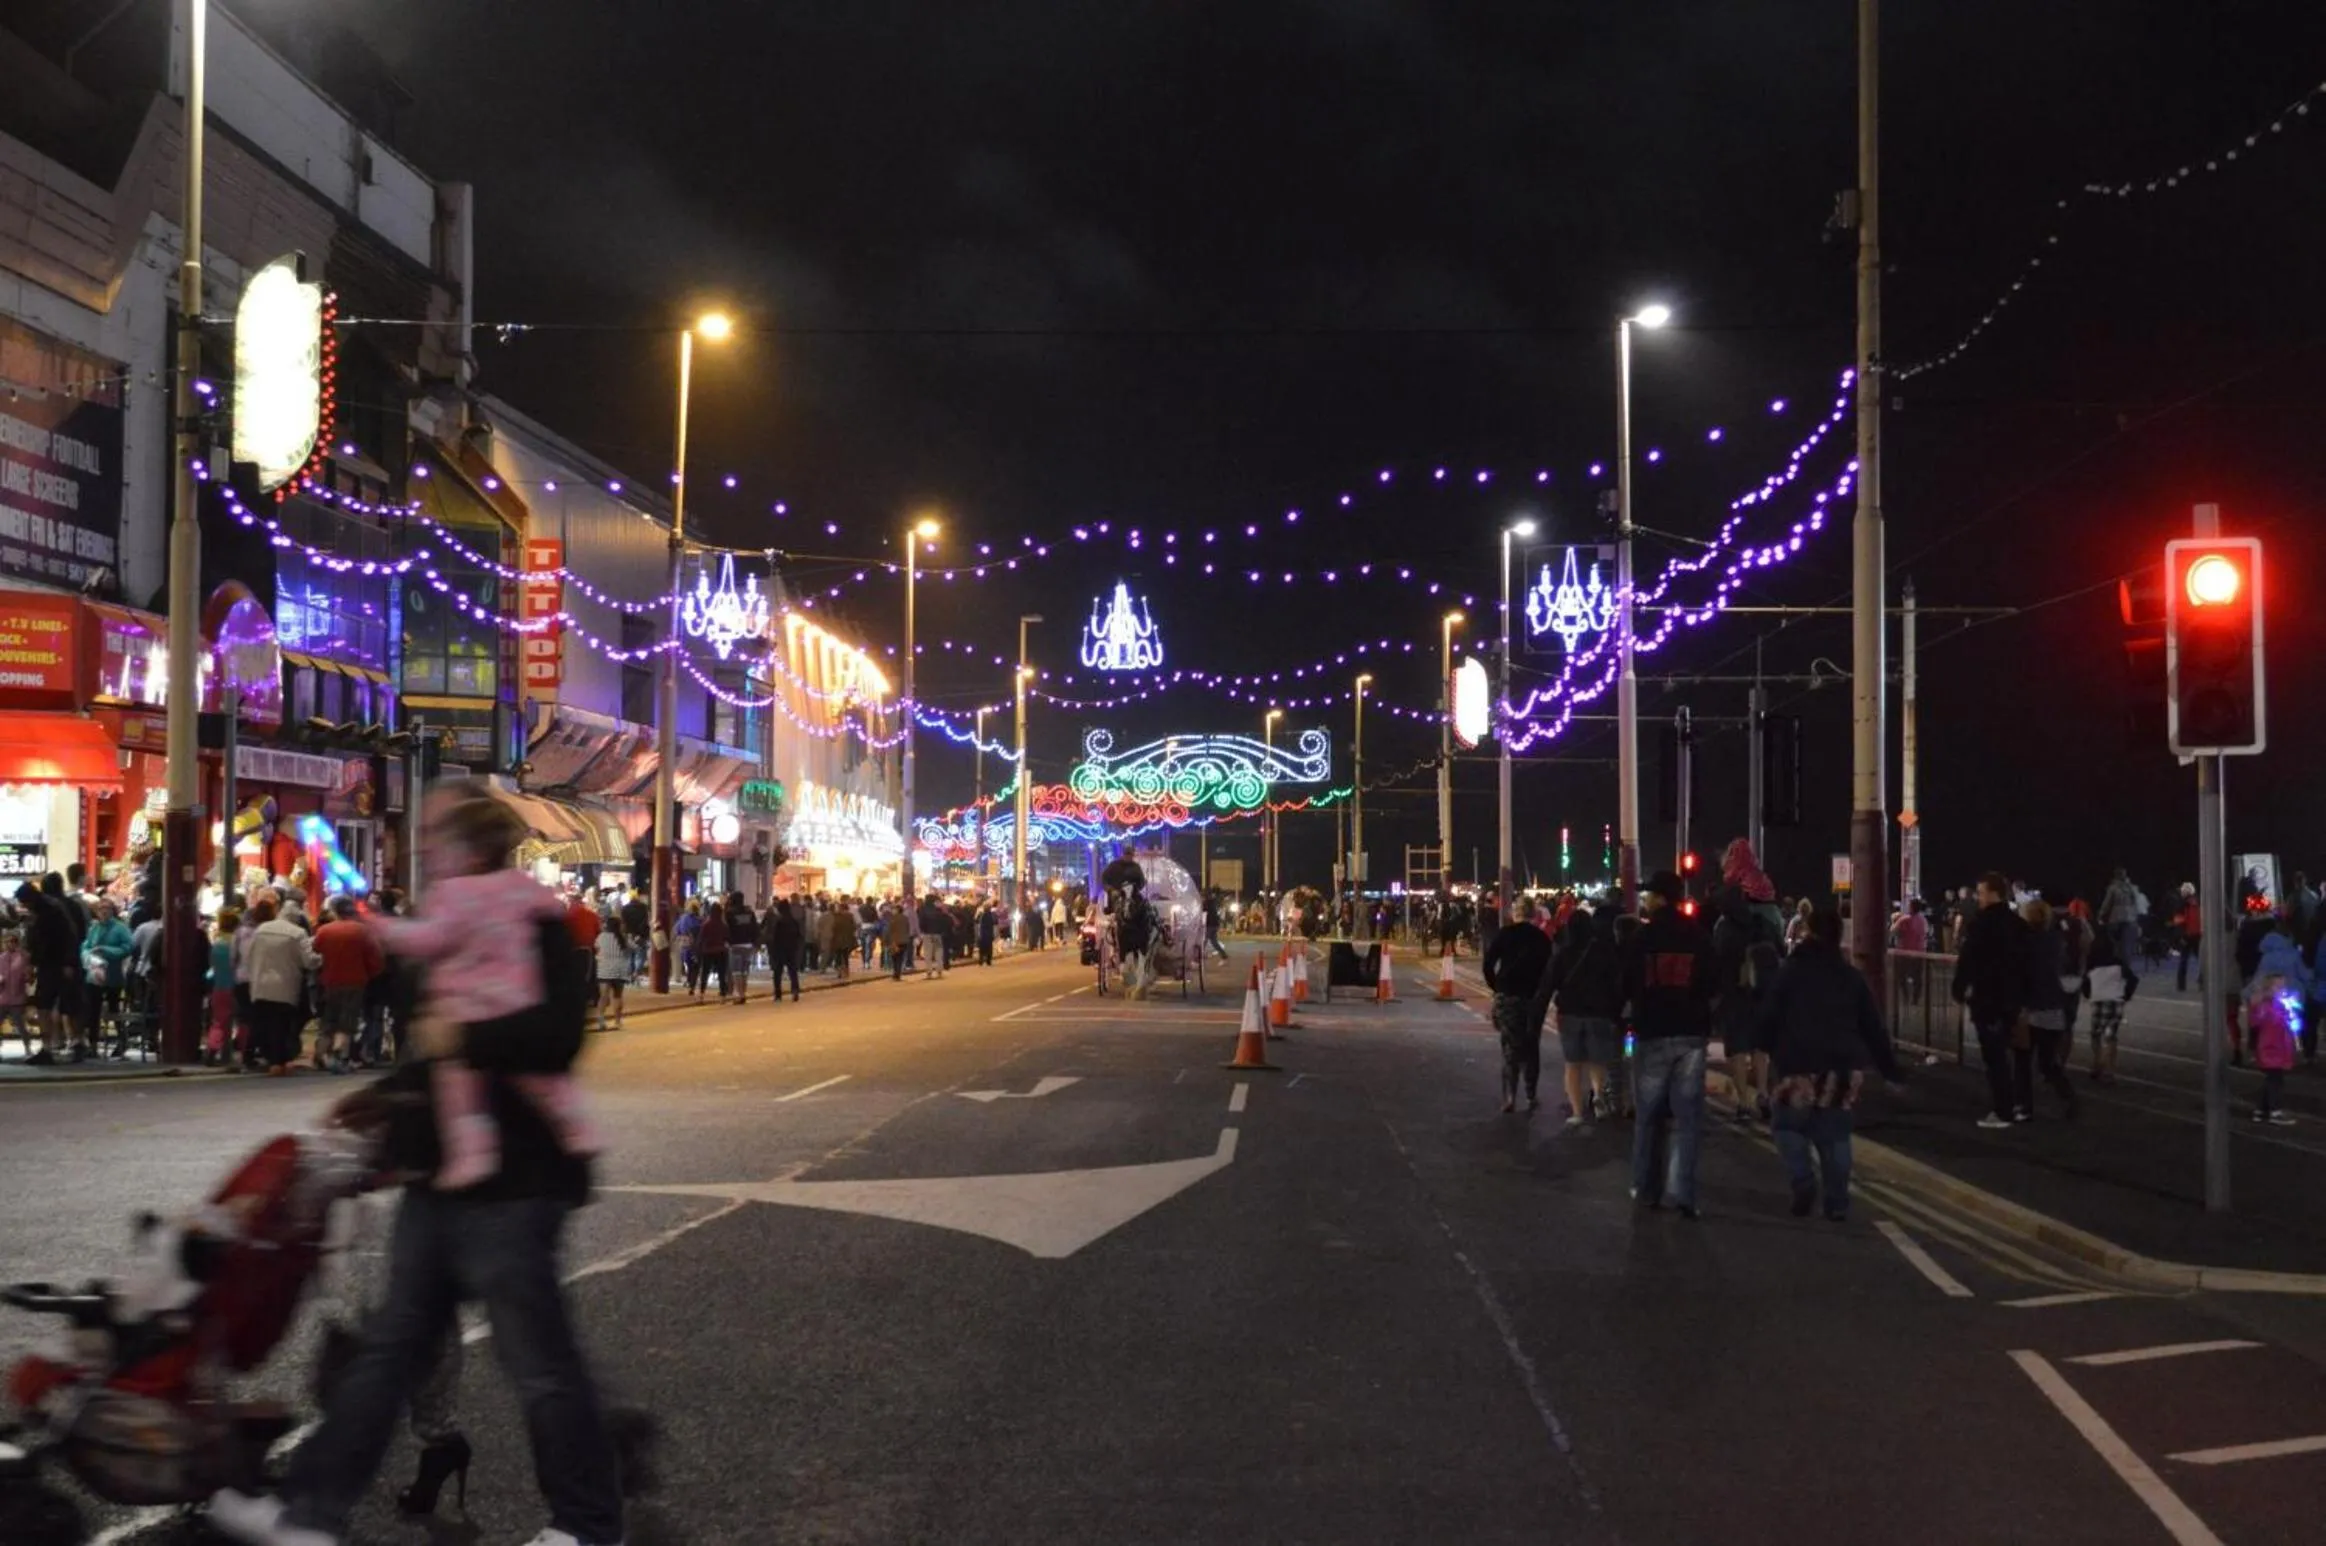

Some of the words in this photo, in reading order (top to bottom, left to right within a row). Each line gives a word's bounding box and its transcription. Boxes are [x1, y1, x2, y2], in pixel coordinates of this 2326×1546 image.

[53, 433, 101, 476] FOOTBALL
[1, 457, 32, 496] LARGE
[33, 468, 79, 510] SCREENS
[58, 521, 74, 553] SAT
[31, 619, 62, 632] LINES
[527, 548, 559, 679] TATTOO
